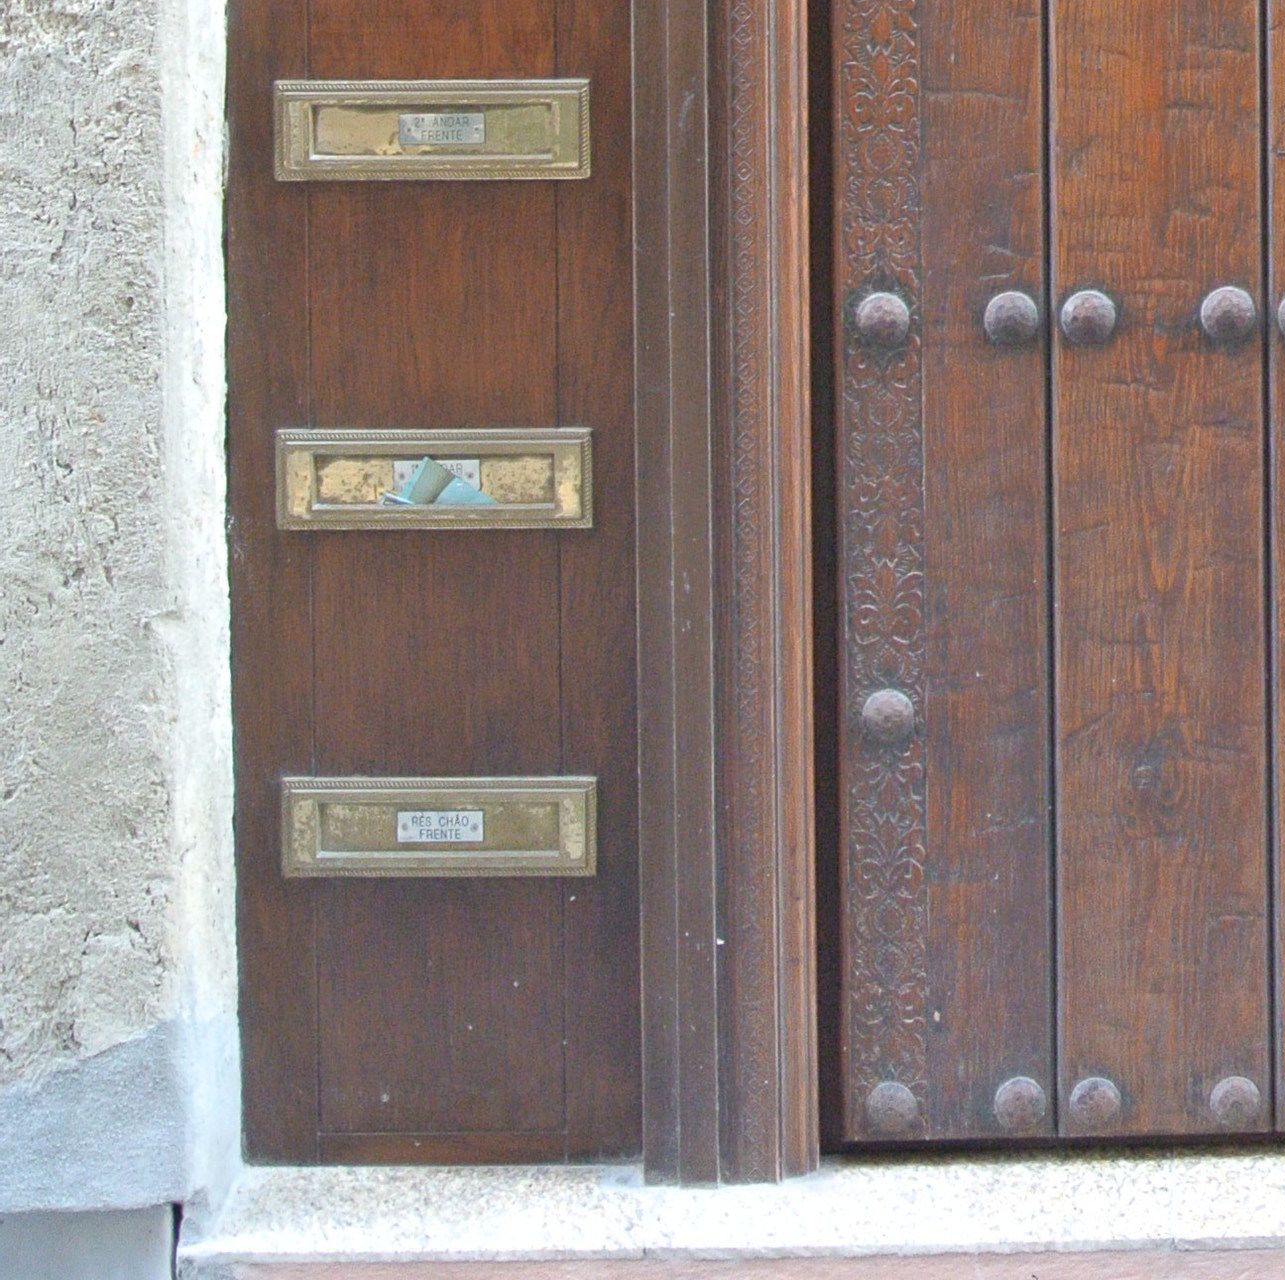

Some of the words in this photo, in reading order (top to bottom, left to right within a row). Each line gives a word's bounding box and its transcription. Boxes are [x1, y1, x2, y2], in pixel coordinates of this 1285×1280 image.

[433, 116, 469, 128] ANDAR
[421, 130, 463, 141] FRENTE
[419, 828, 462, 840] FRENTE
